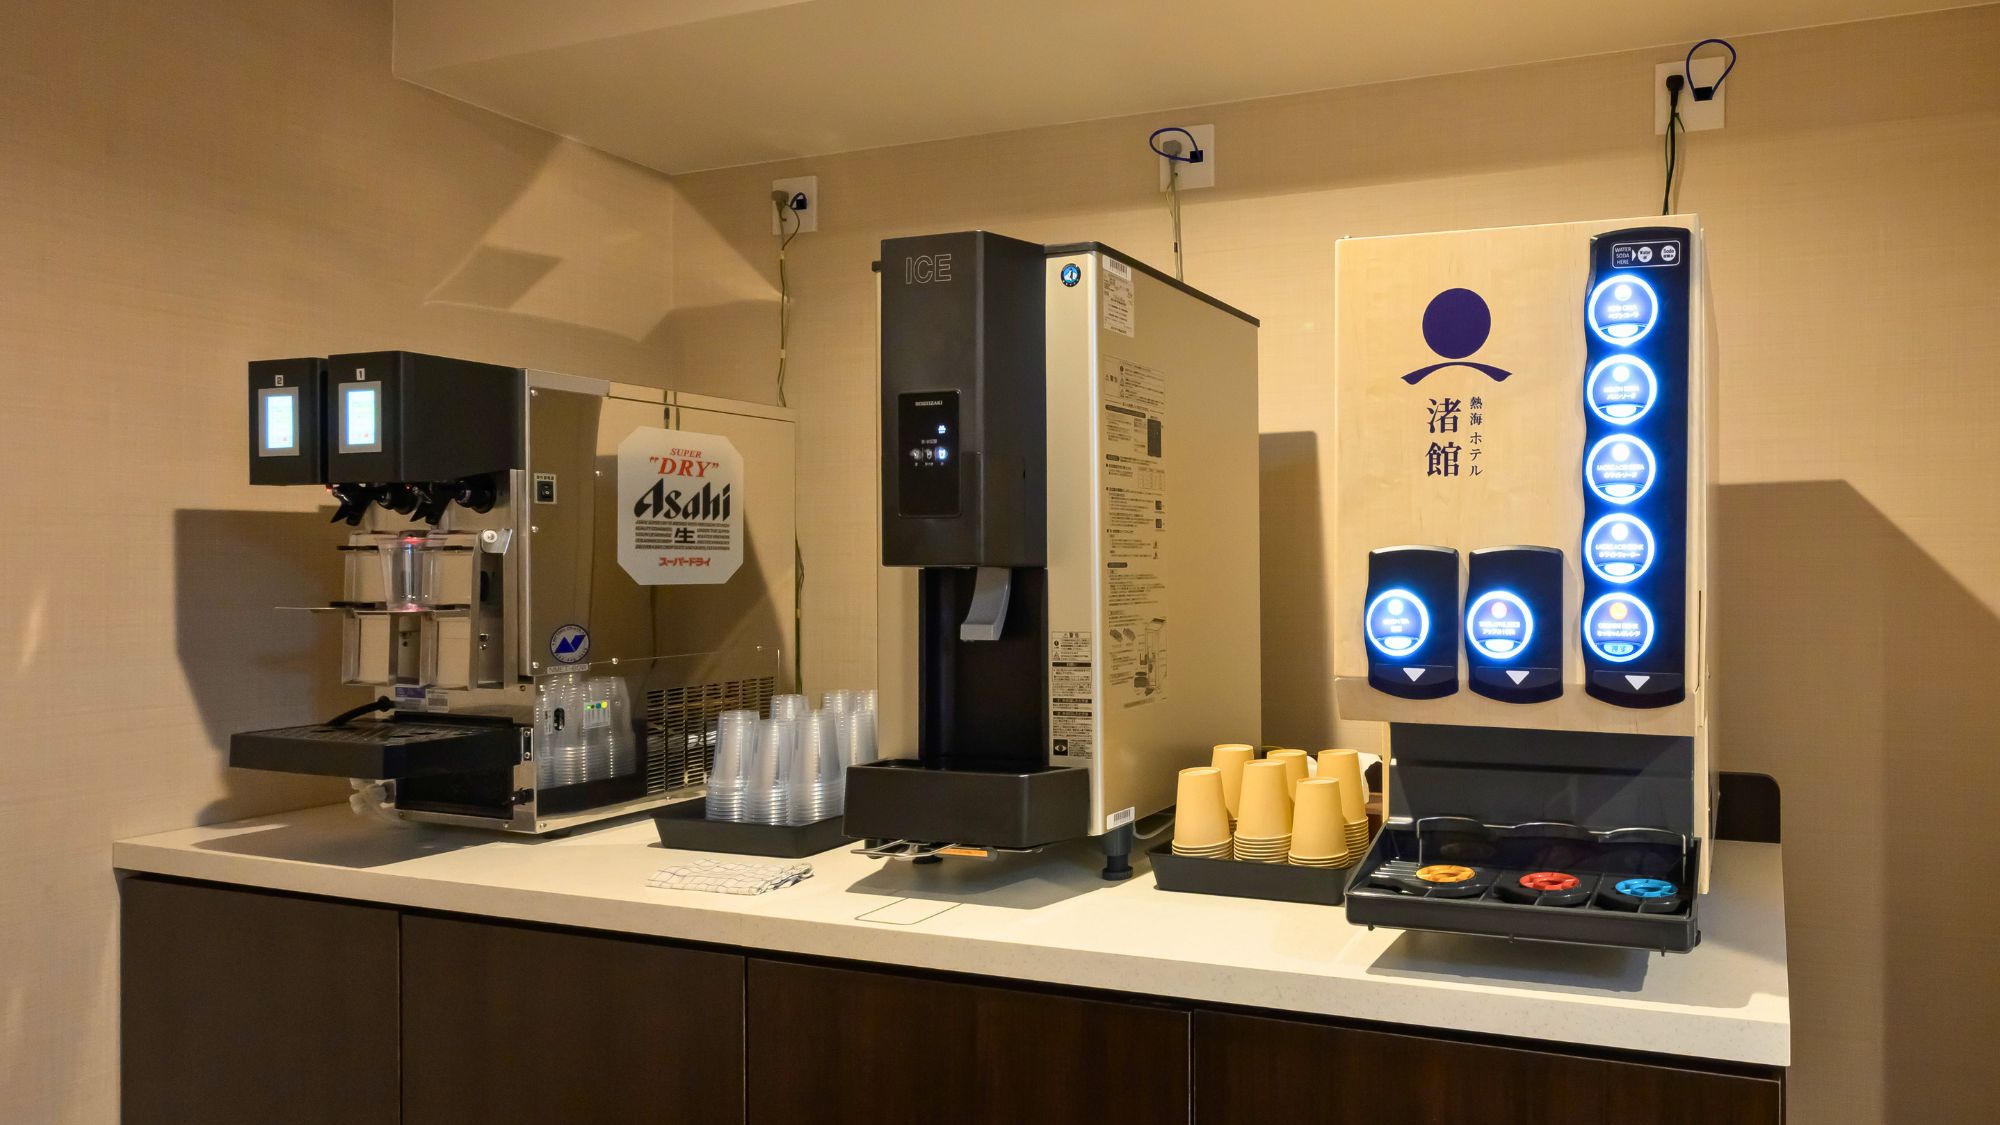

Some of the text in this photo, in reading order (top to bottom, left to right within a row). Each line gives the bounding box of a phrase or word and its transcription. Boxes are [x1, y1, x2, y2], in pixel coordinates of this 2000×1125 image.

[906, 254, 951, 284] ICE
[358, 370, 363, 379] 1
[1425, 398, 1462, 477] 渚館
[1469, 396, 1483, 477] 熱海ホテル
[670, 448, 702, 458] SUPER
[634, 478, 730, 521] Asahi
[674, 528, 696, 544] 生
[659, 557, 711, 566] スーパードライ
